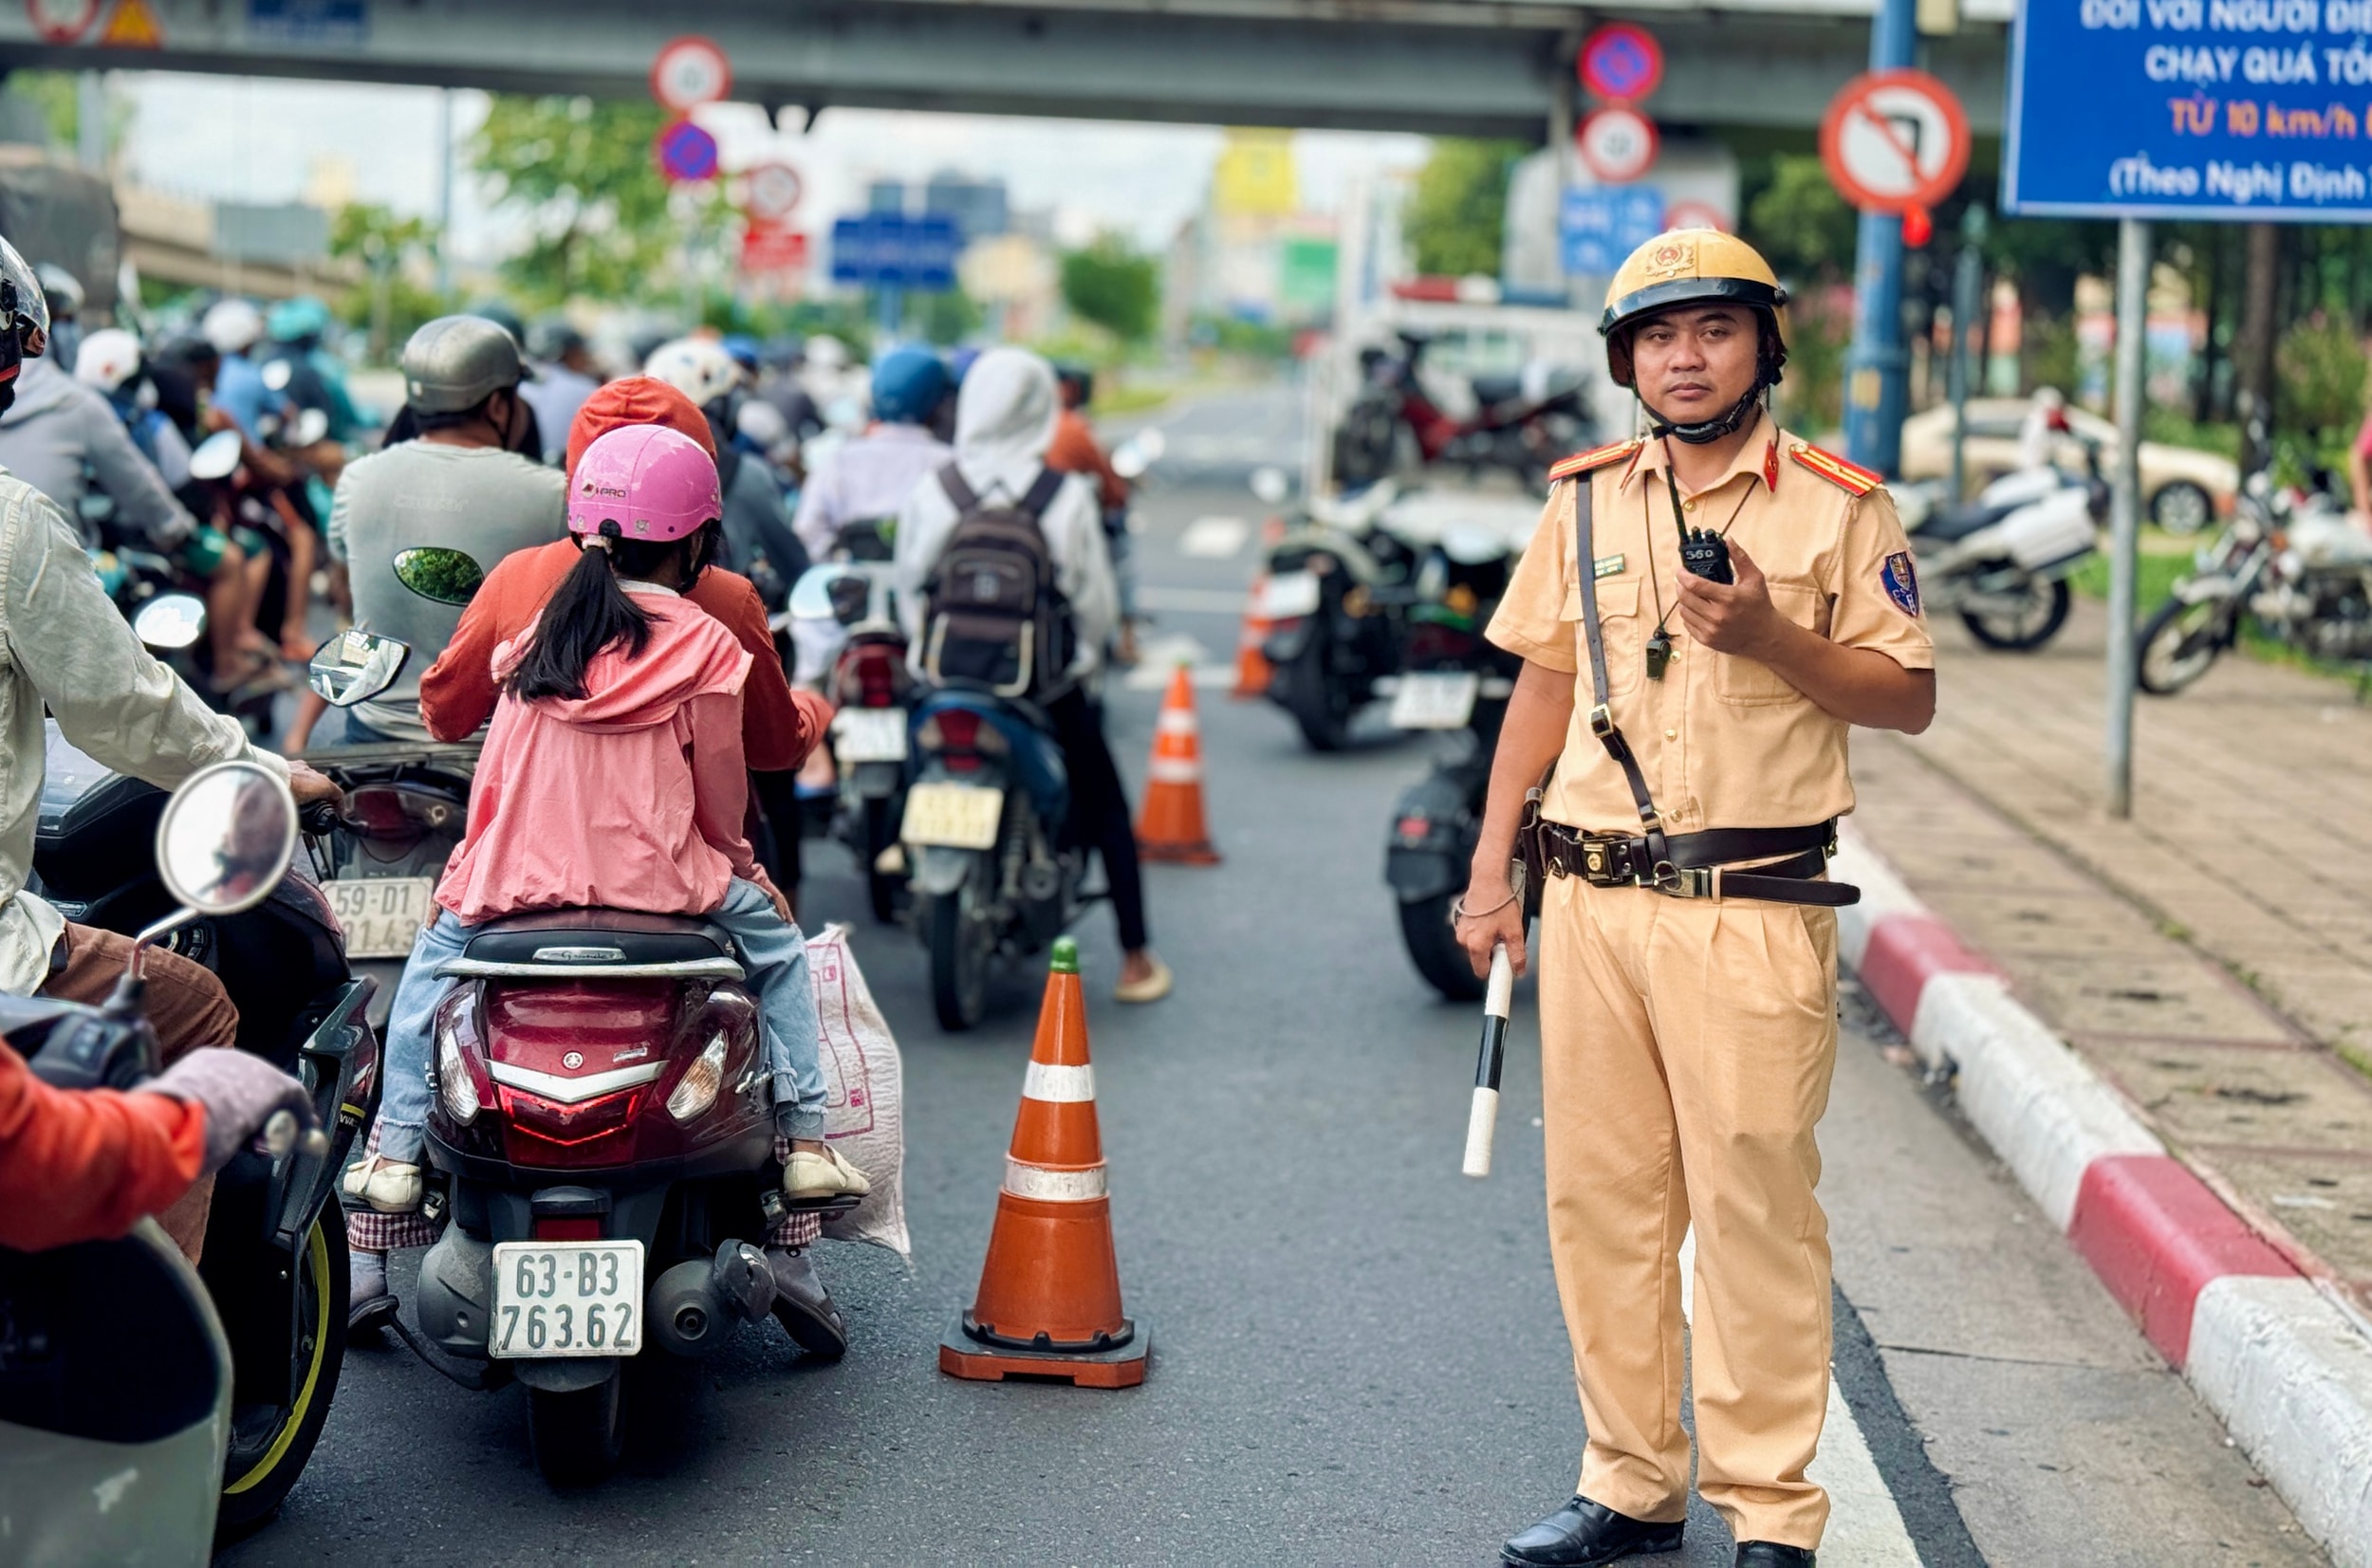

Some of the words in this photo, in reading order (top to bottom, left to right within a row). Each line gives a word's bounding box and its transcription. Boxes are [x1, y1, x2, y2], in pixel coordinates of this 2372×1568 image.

[2145, 45, 2239, 88] CHẠY
[2242, 39, 2317, 84] QUÁ
[2323, 34, 2372, 85] TỐ
[2167, 89, 2219, 136] TỪ
[2225, 99, 2259, 138] 10
[2266, 100, 2358, 140] km/h
[2108, 150, 2199, 198] (Theo
[2206, 159, 2283, 205] Nghị
[2289, 160, 2366, 205] Định
[335, 884, 411, 916] 59-D1
[516, 1252, 619, 1298] 63-B3
[502, 1302, 632, 1350] 763.62
